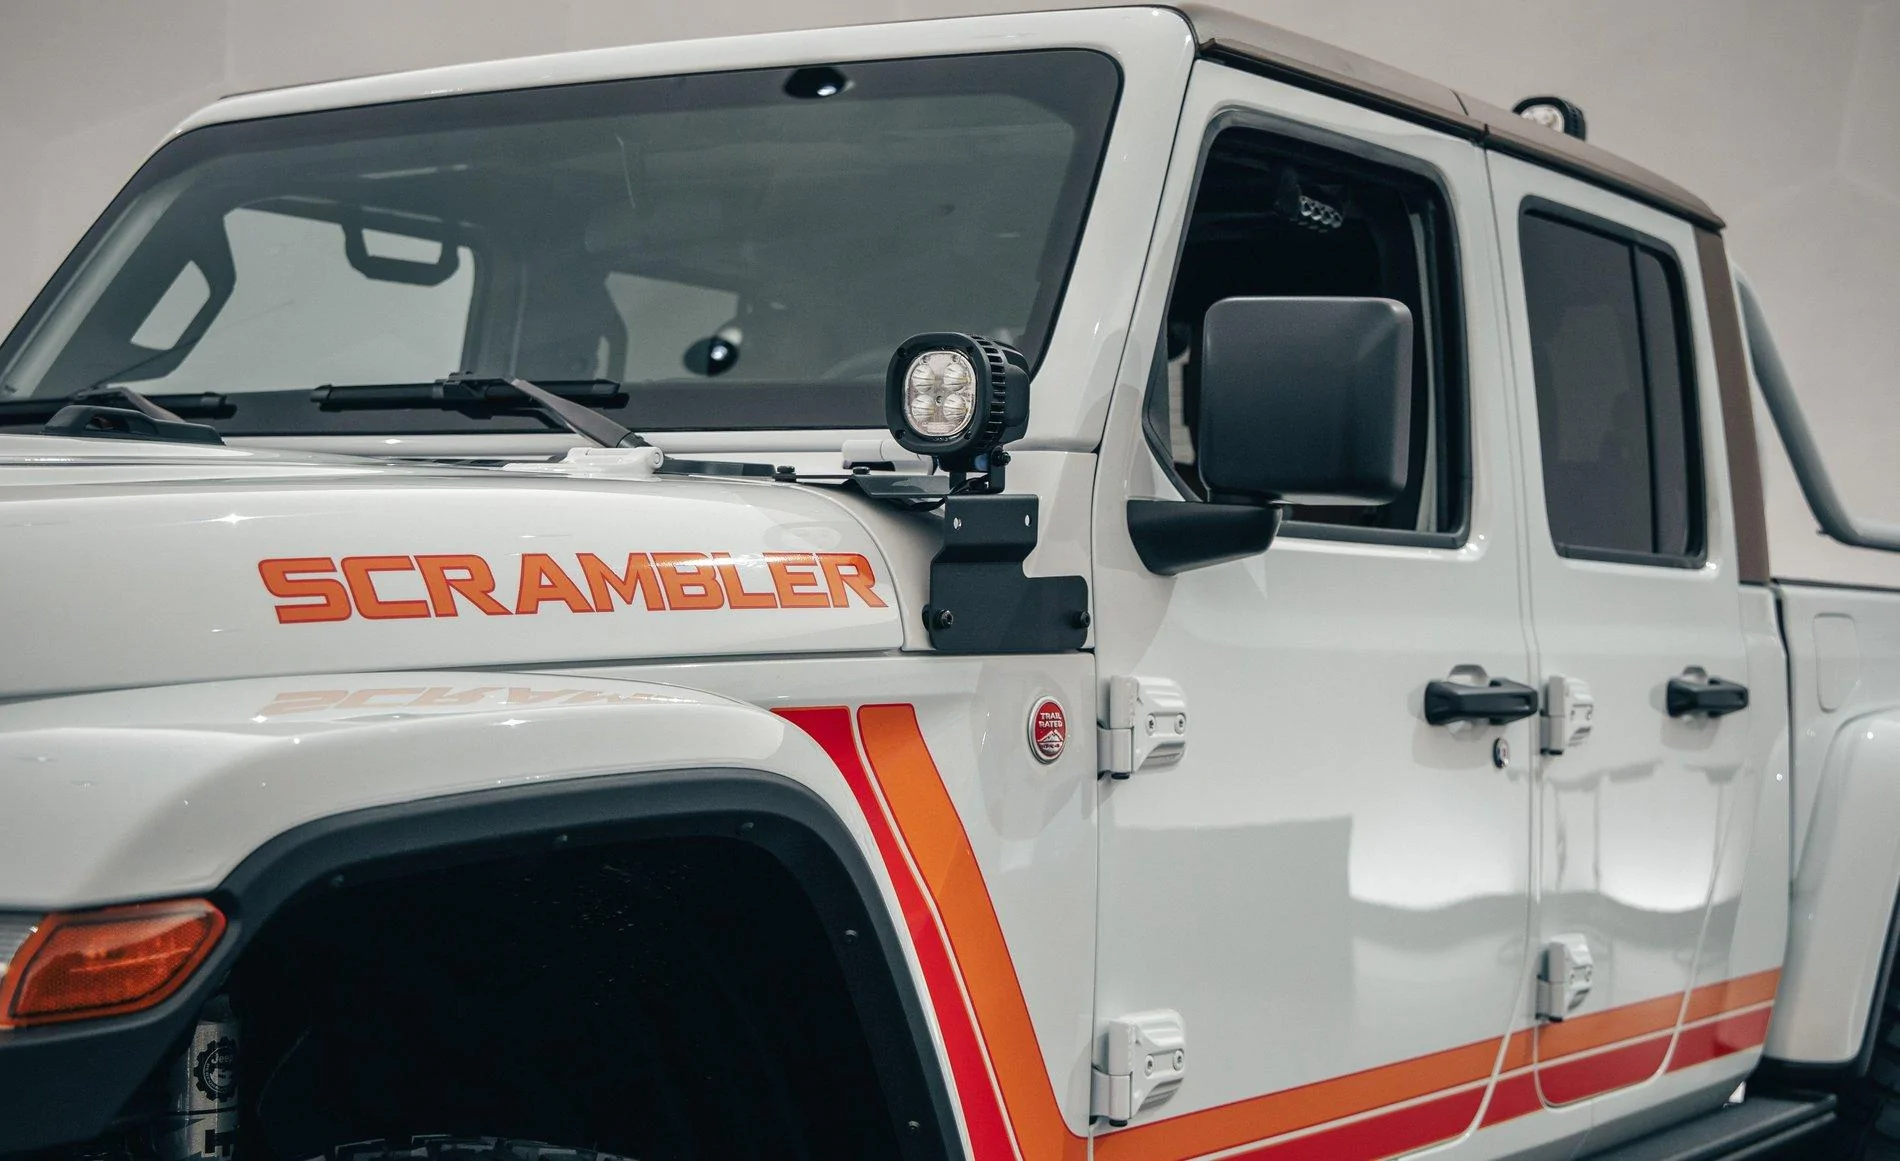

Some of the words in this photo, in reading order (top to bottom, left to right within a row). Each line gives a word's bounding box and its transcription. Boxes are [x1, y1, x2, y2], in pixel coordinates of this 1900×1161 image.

[258, 552, 890, 624] SCRAMBLER
[1040, 712, 1062, 720] TRAIL
[1038, 720, 1063, 728] RATED
